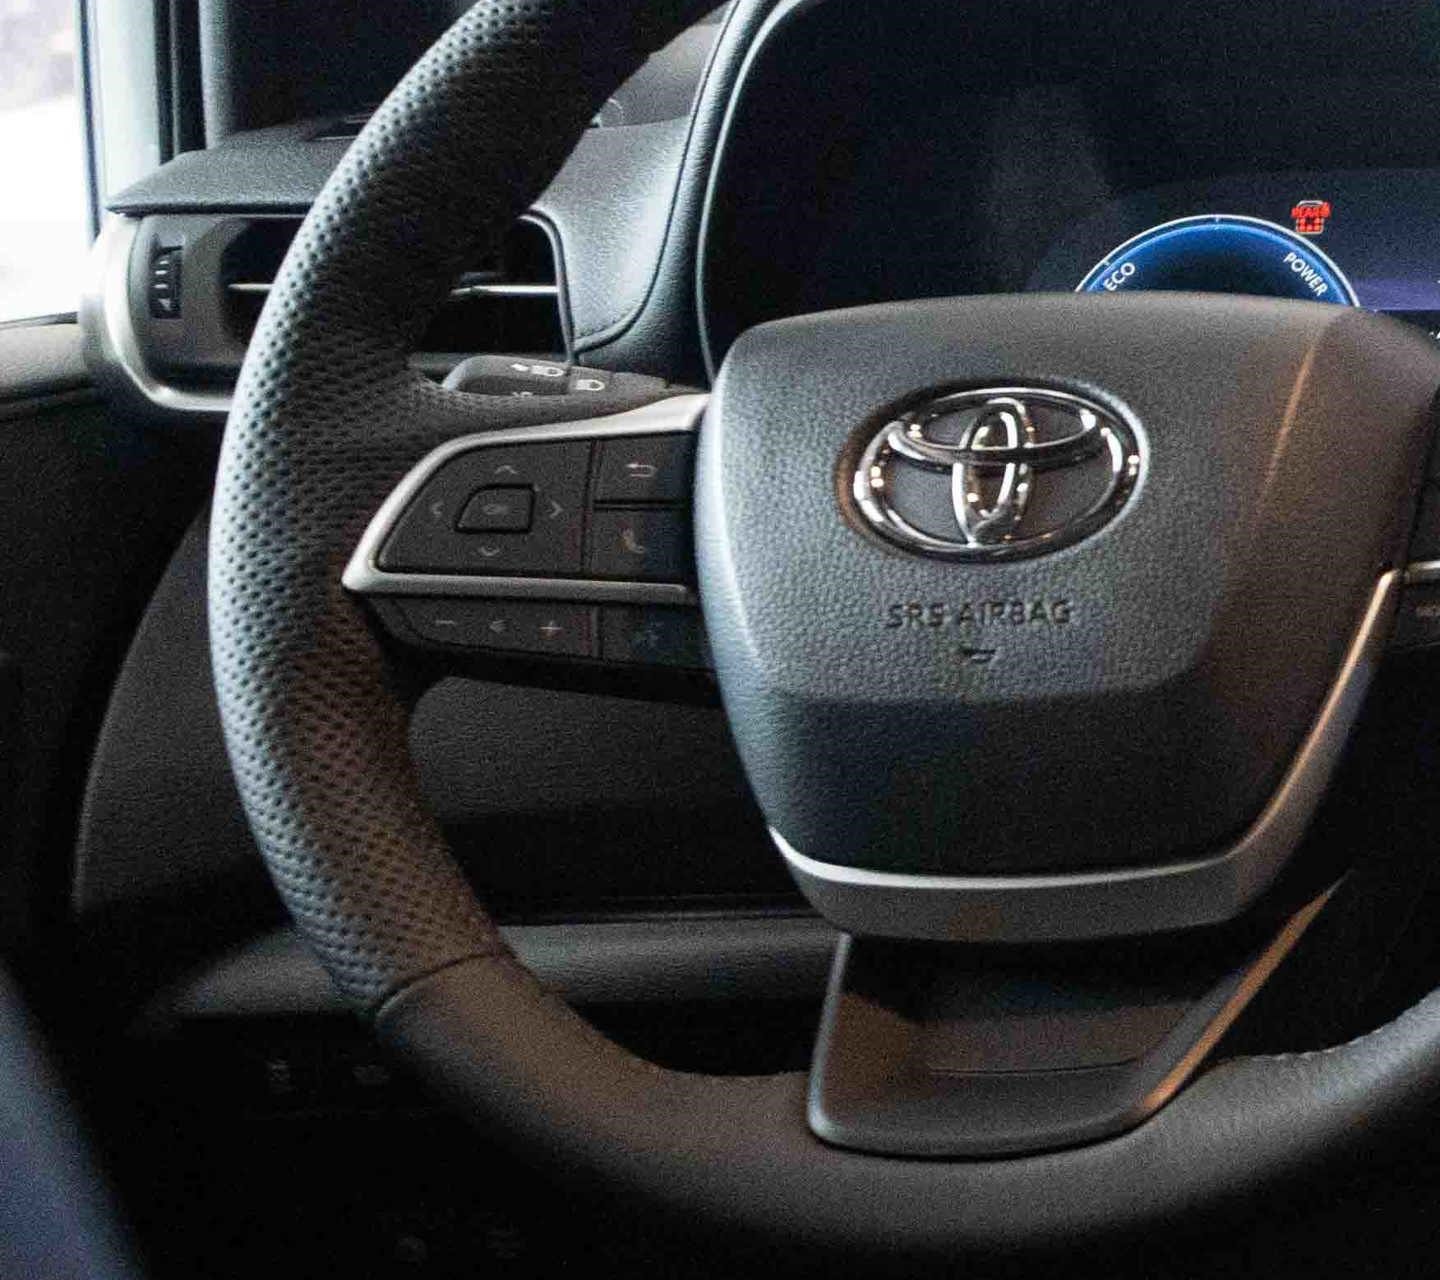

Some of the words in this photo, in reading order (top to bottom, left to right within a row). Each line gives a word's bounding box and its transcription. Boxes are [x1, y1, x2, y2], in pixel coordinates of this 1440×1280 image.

[1104, 261, 1137, 293] ECO
[1283, 250, 1330, 298] POWER
[884, 599, 946, 629] SRS
